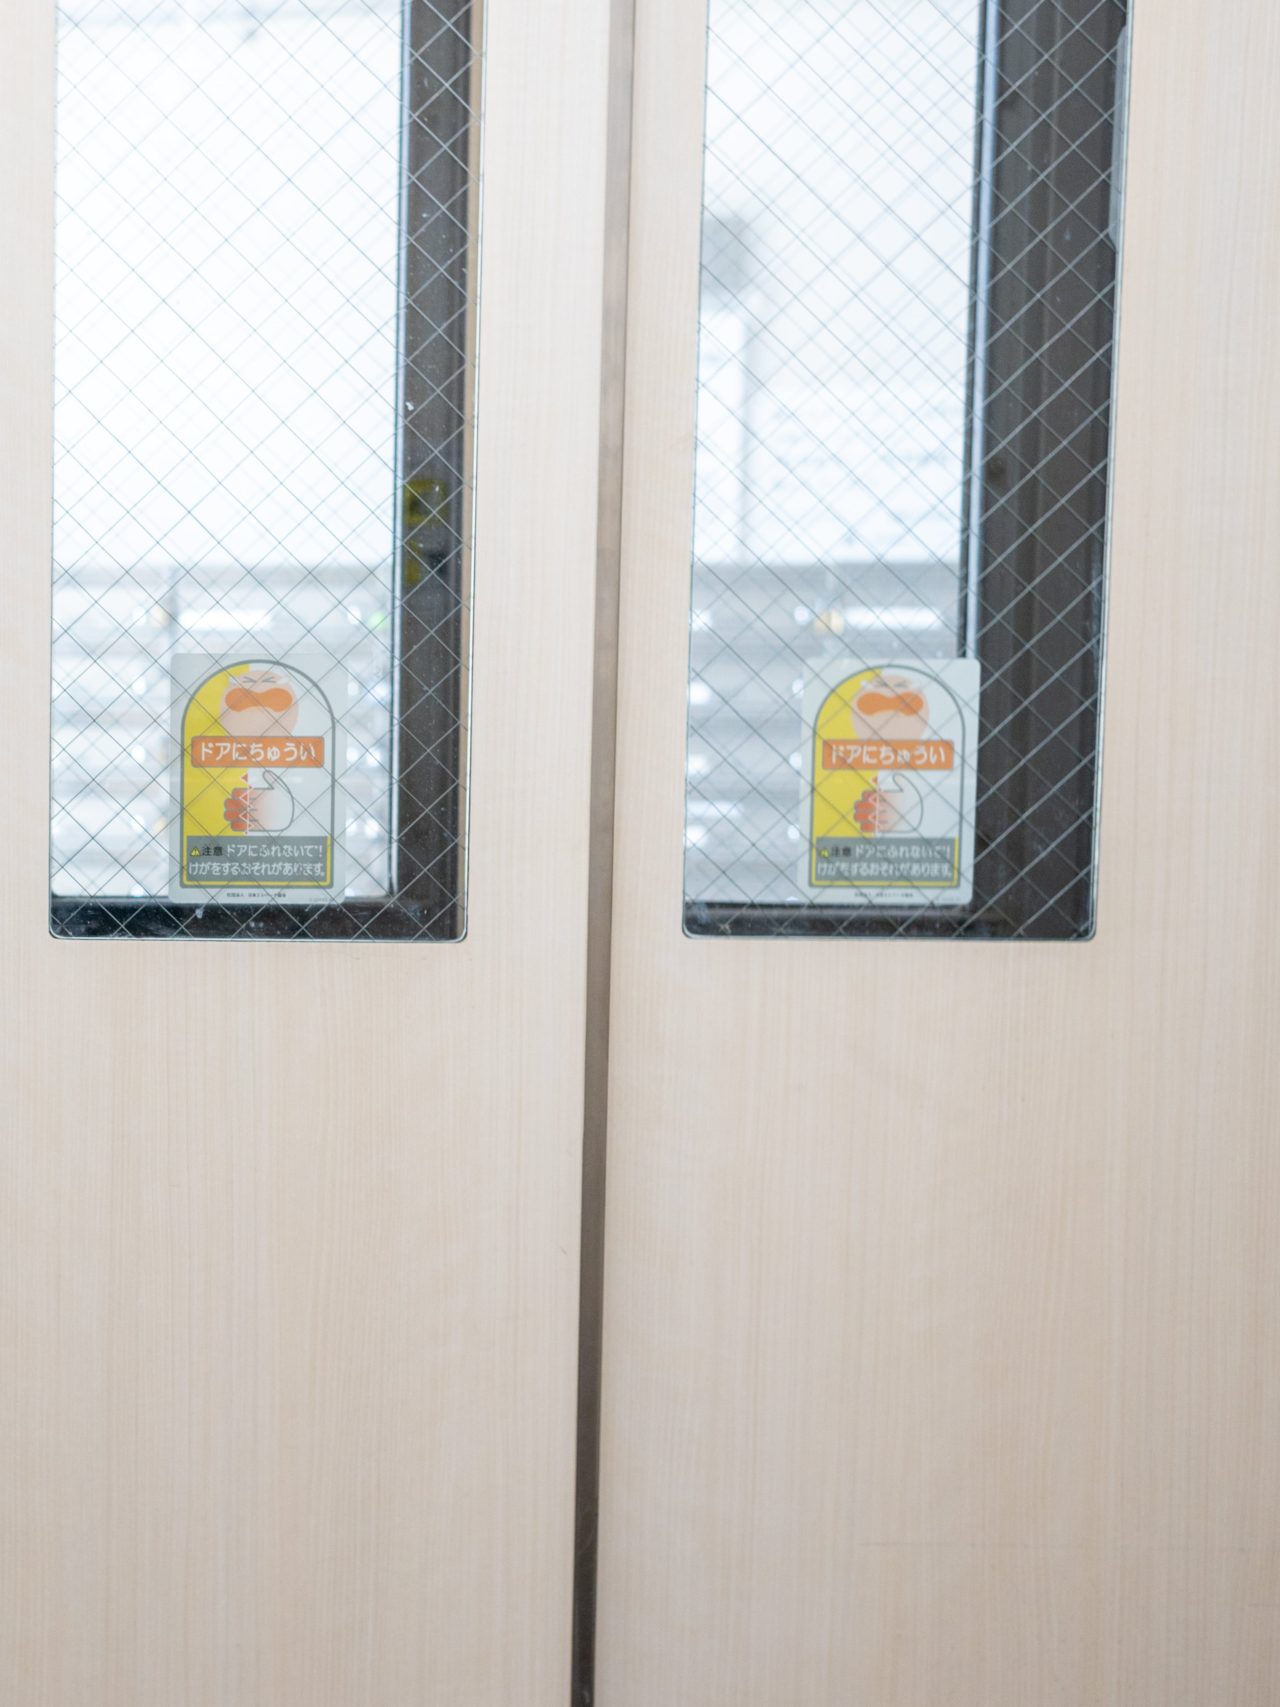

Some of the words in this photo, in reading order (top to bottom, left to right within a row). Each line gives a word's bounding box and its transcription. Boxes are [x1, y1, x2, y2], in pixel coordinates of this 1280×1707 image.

[200, 742, 316, 762] ドアにちゅうい
[831, 745, 946, 765] ドアにちゅうい
